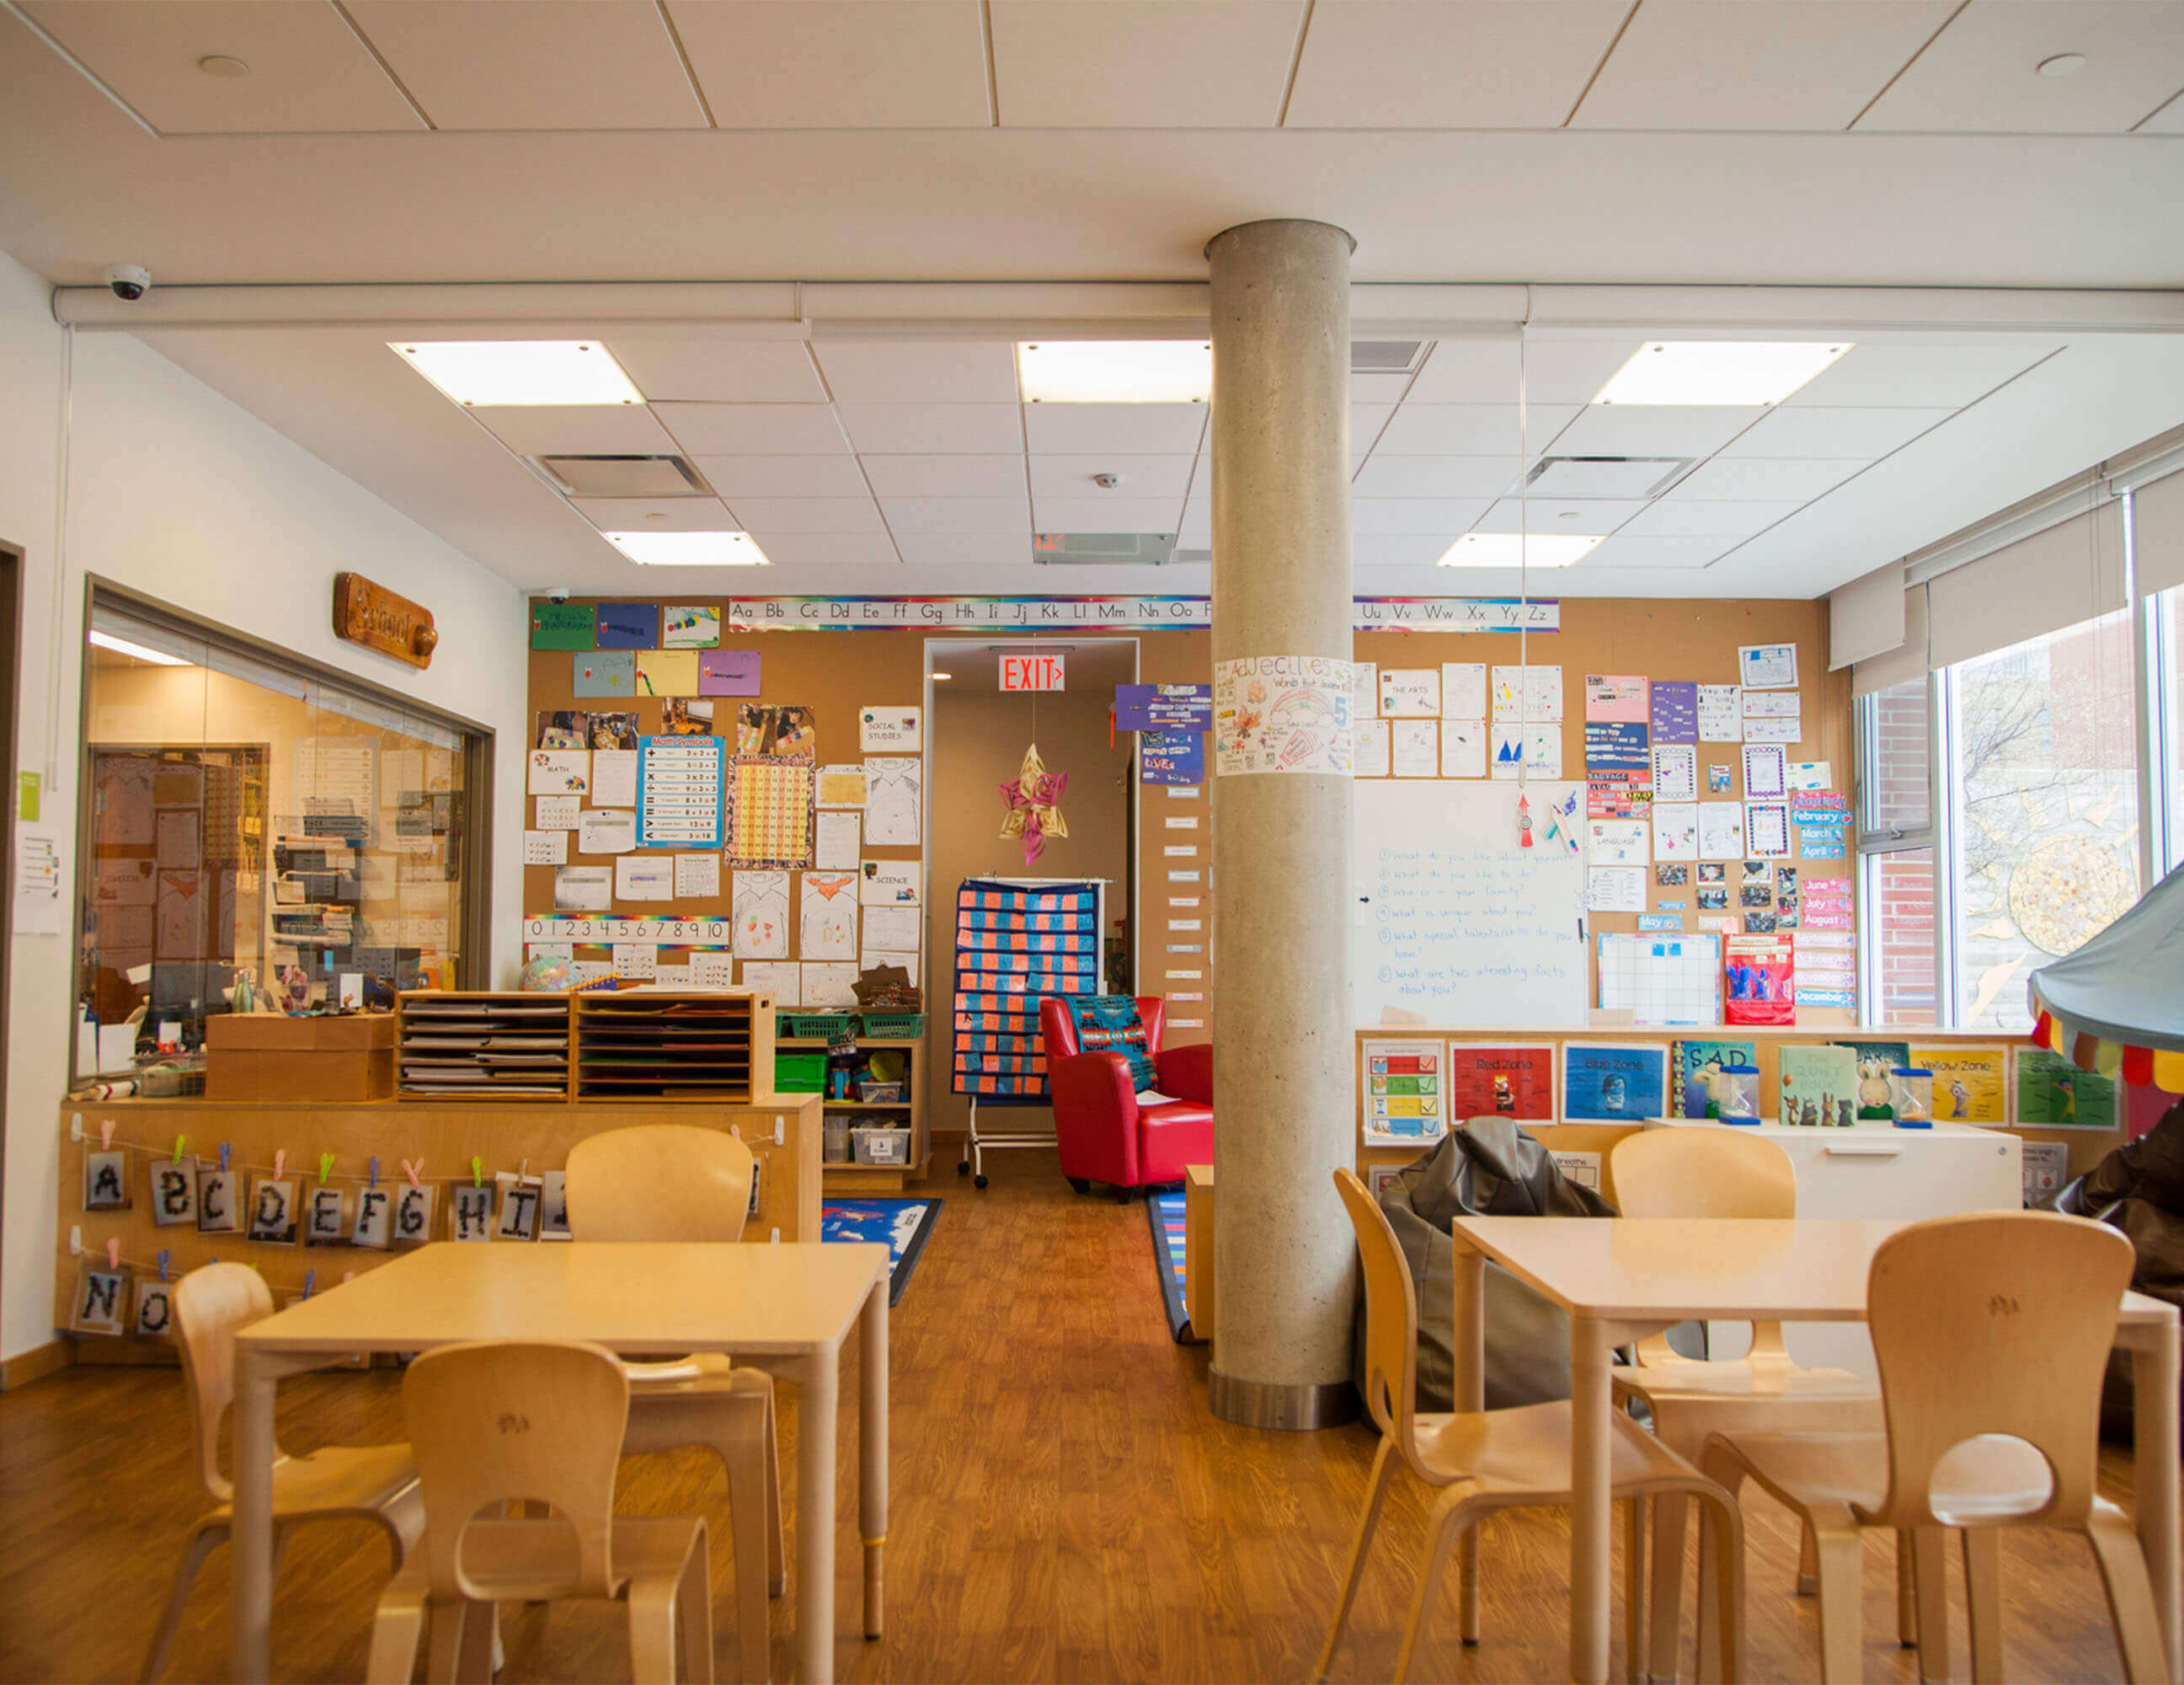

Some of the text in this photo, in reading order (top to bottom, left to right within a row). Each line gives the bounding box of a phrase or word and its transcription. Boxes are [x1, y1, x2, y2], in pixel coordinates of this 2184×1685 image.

[732, 603, 753, 618] Aa
[766, 603, 784, 618] Bb
[800, 603, 819, 618] Cc
[830, 602, 850, 618] Dd
[862, 603, 879, 618] Ee
[894, 602, 908, 618] Ff
[921, 603, 943, 623] Gg
[956, 603, 975, 618] Hh
[989, 603, 998, 618] Ii
[1012, 603, 1028, 624] Jj
[1041, 603, 1060, 618] Kk
[1073, 603, 1087, 618] Ll
[1098, 603, 1126, 618] Mm
[1139, 603, 1159, 618] Nn
[1169, 602, 1193, 618] Oo
[1362, 604, 1546, 625] Uu Vv Ww Xx Yy Zz
[1004, 658, 1055, 689] EXIT
[676, 738, 713, 747] Symbols
[868, 732, 902, 741] STUDIES
[1792, 810, 1838, 823] February
[1802, 828, 1832, 837] March
[1597, 837, 1637, 846] LANGUAGE
[1804, 846, 1827, 857] April
[1806, 880, 1828, 890] June
[1806, 898, 1826, 910] July
[1642, 916, 1663, 928] May
[1804, 914, 1839, 926] August
[531, 921, 723, 937] 0 1 2 3 4 5 6 7 8 9 10
[1795, 990, 1844, 1002] December
[1476, 1059, 1533, 1070] Red Zone
[1585, 1058, 1644, 1071] Blue Zone
[1690, 1048, 1746, 1069] SAD
[1798, 1065, 1843, 1078] QUIET
[1920, 1060, 1991, 1071] Yellow Zone
[95, 1164, 537, 1239] A B C D E F G H I
[83, 1276, 168, 1331] N O
